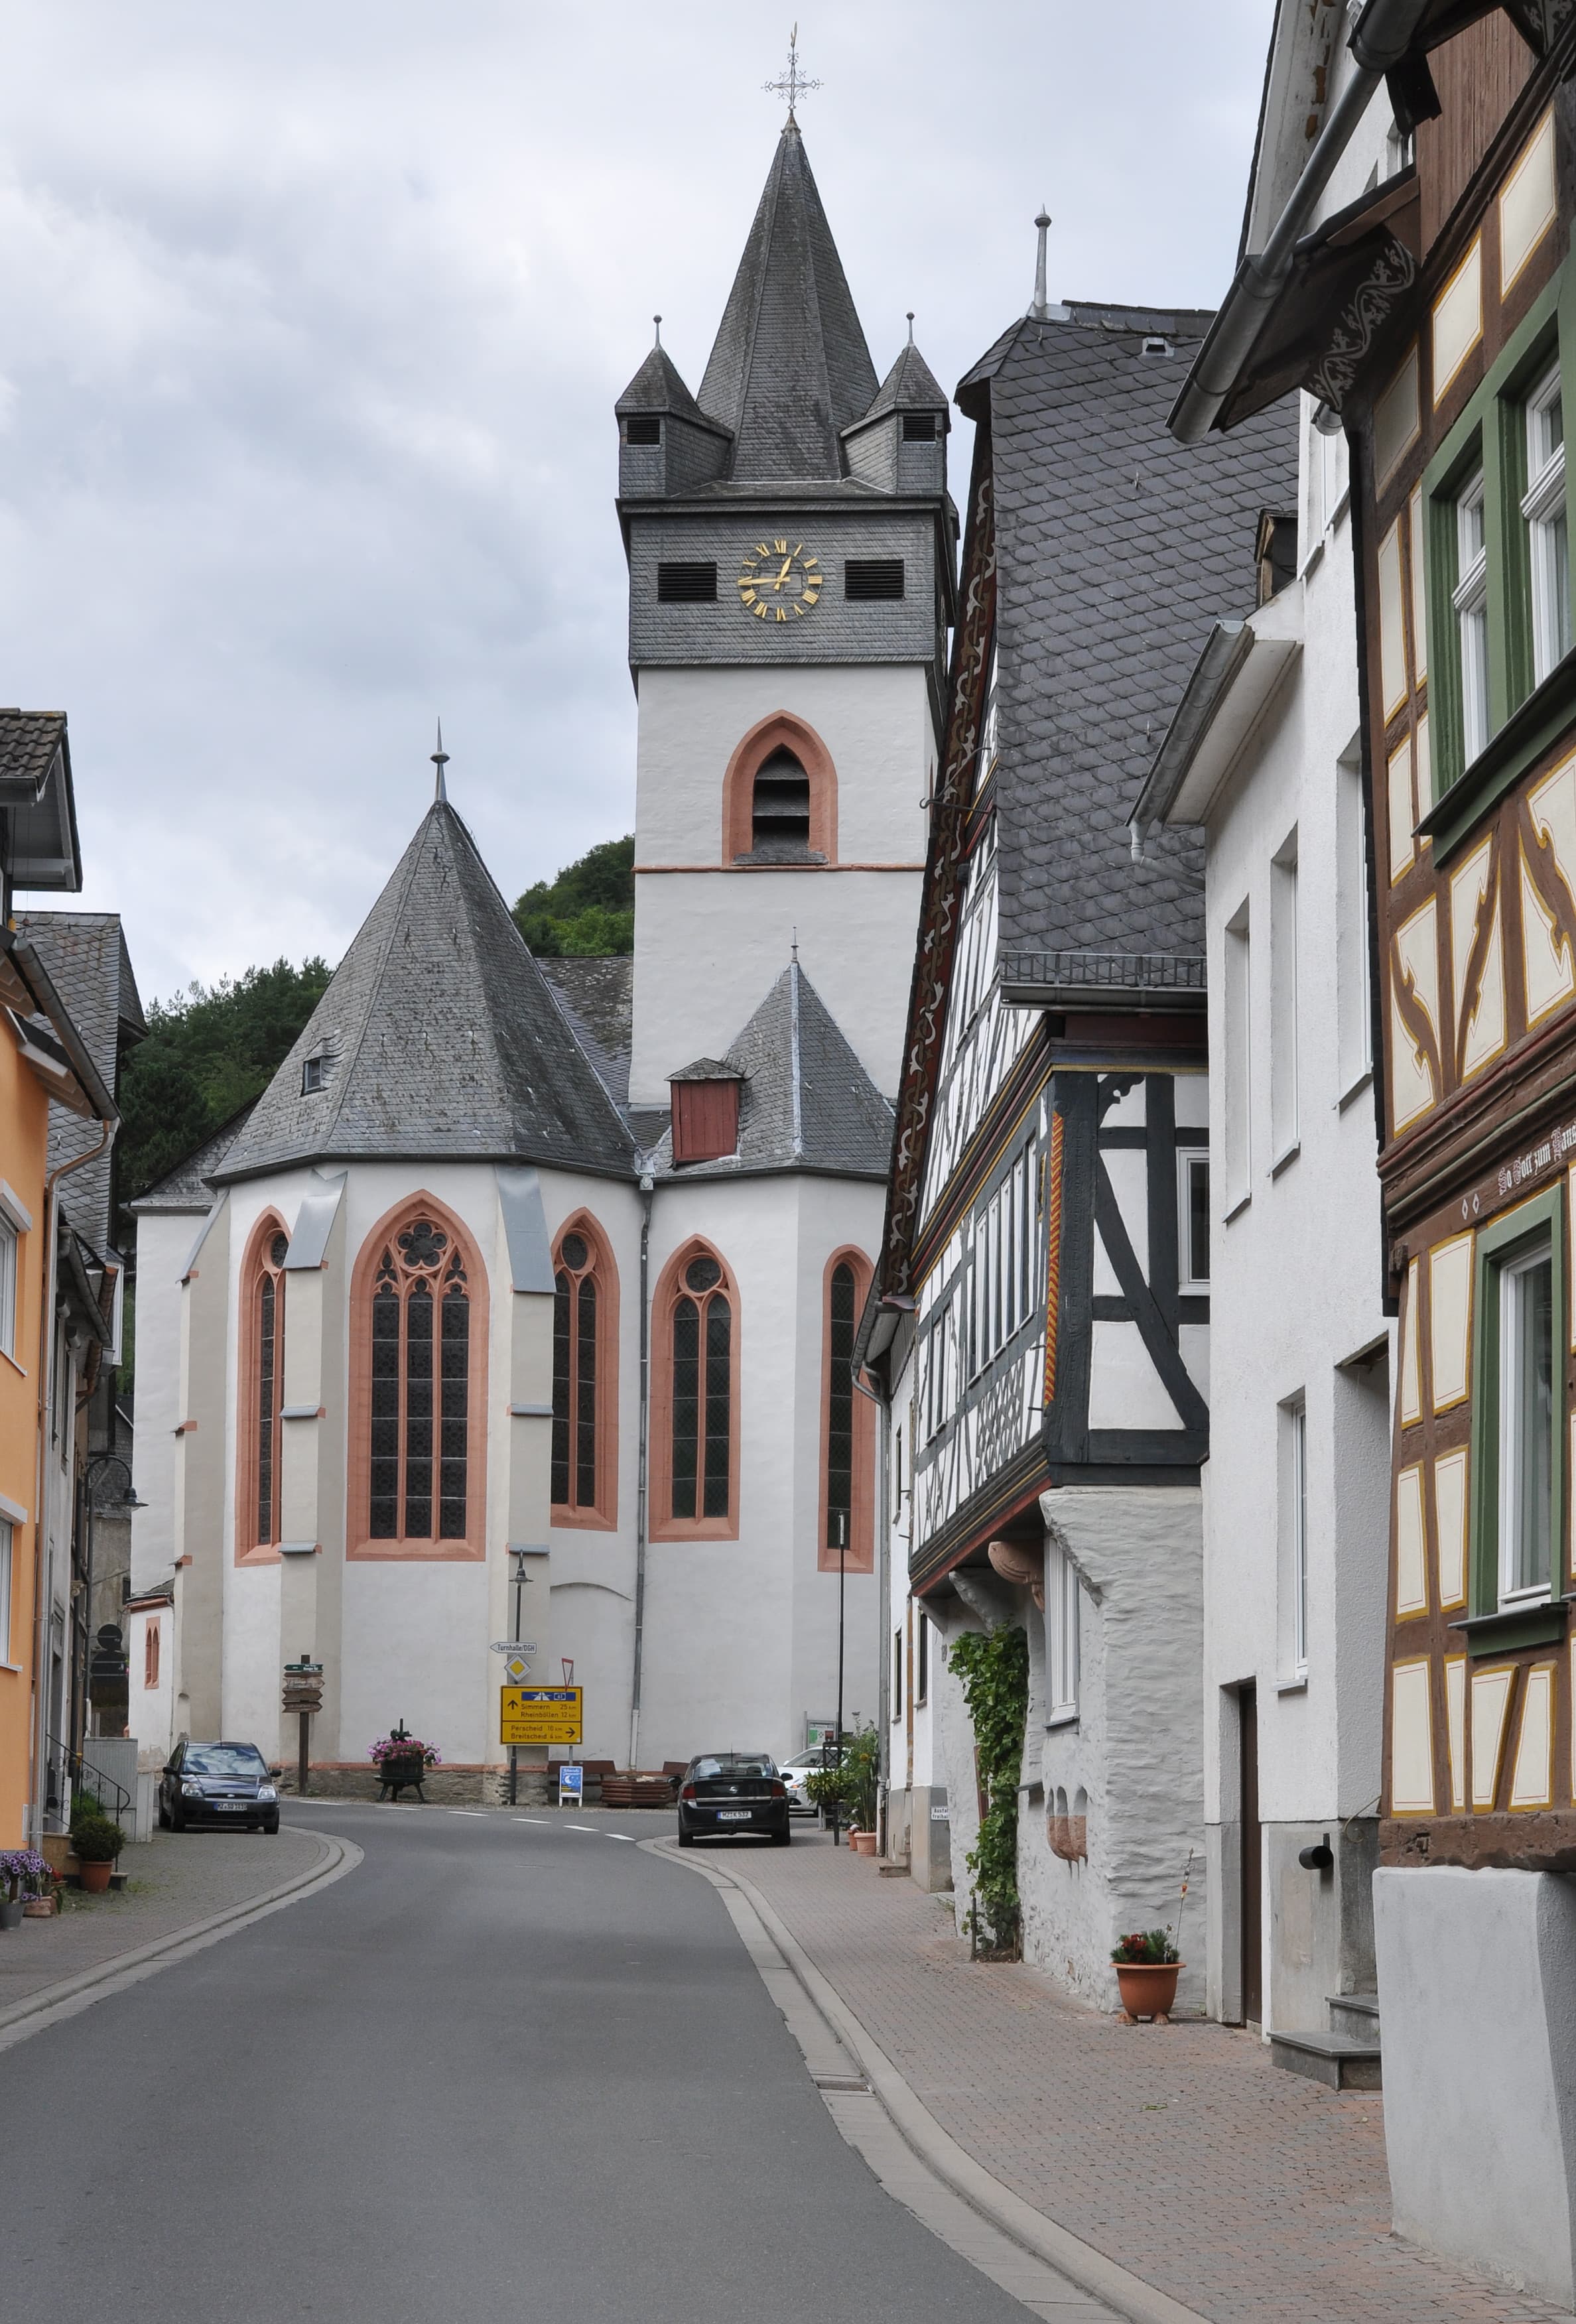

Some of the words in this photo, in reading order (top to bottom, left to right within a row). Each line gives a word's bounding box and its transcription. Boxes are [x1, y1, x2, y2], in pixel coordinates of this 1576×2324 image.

[755, 543, 770, 558] XI
[775, 539, 787, 554] XII
[794, 544, 803, 557] I
[803, 557, 818, 568] II
[808, 575, 822, 584] III
[1534, 1143, 1551, 1175] zum
